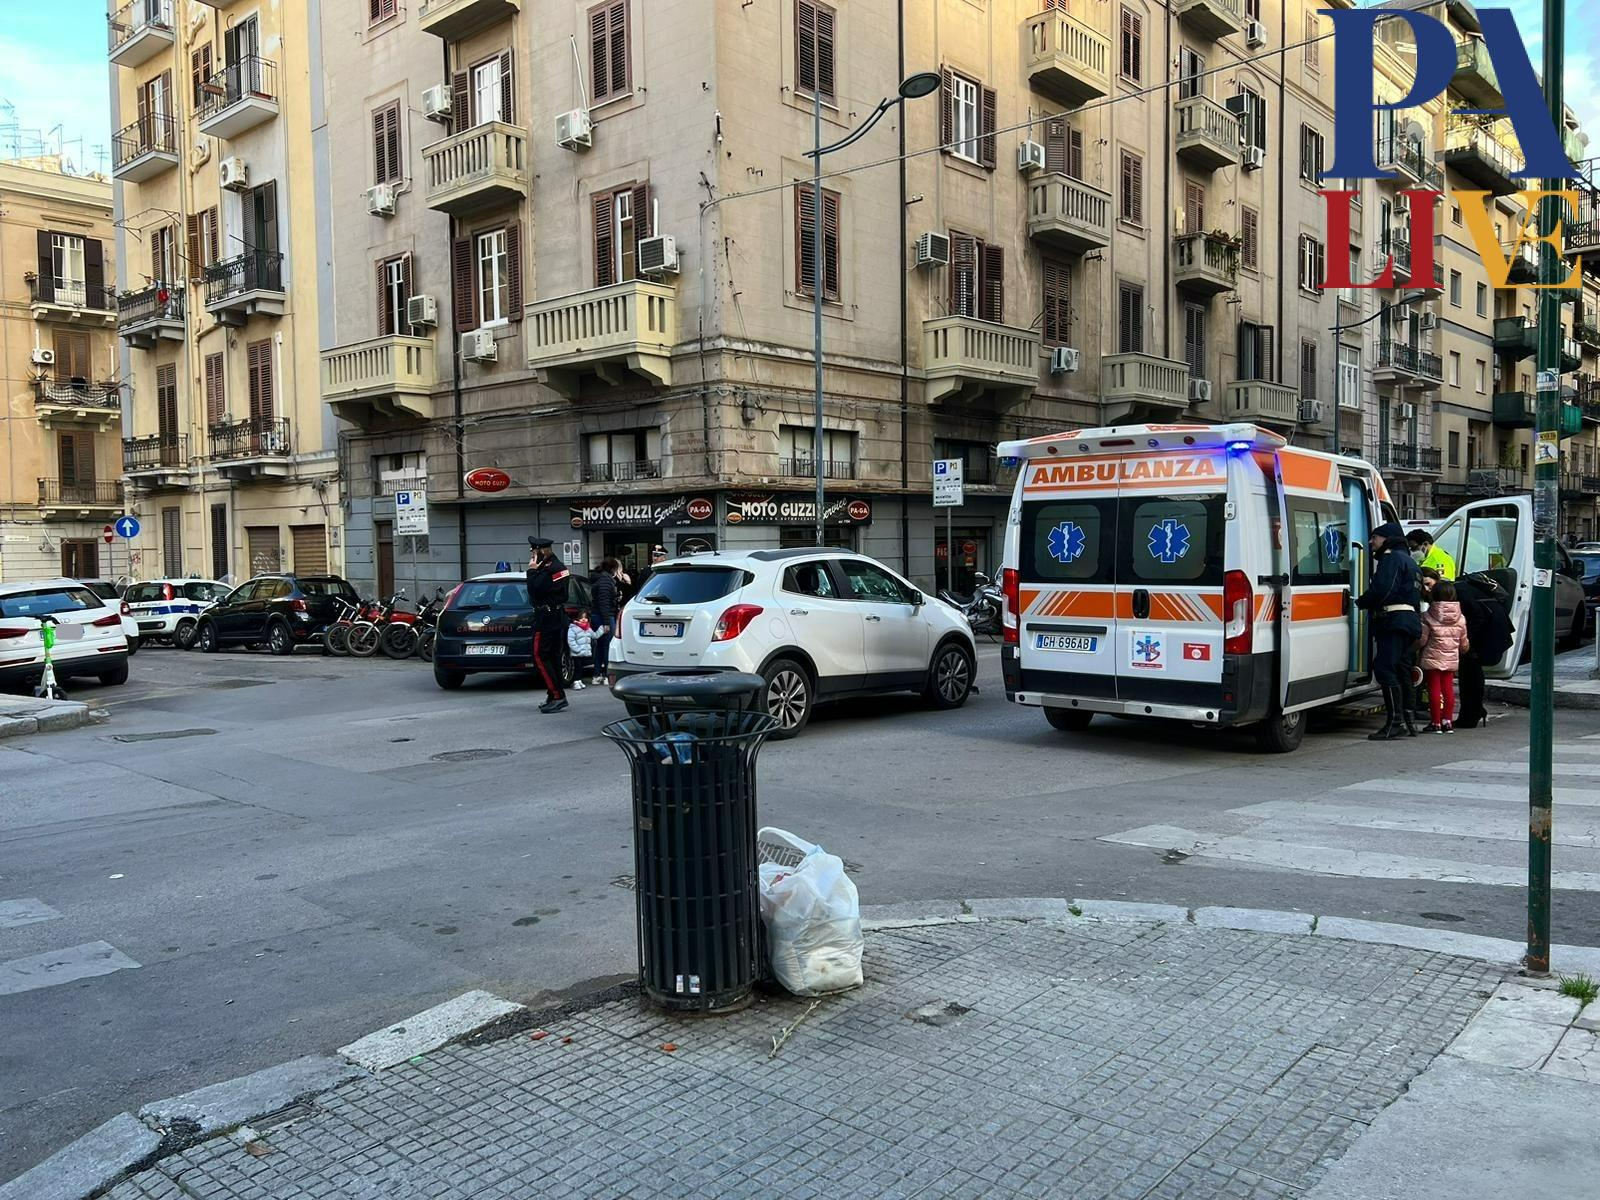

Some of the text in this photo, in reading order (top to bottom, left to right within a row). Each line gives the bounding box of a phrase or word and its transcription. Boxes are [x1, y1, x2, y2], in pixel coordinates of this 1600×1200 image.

[1031, 458, 1216, 485] AMBULANZA
[583, 496, 686, 525] MOTO GUZZI Service
[689, 506, 711, 514] PA-GA
[741, 497, 847, 519] MOTO GUZZI ervice
[456, 625, 513, 633] CABINIERI
[1058, 637, 1090, 650] 696AB
